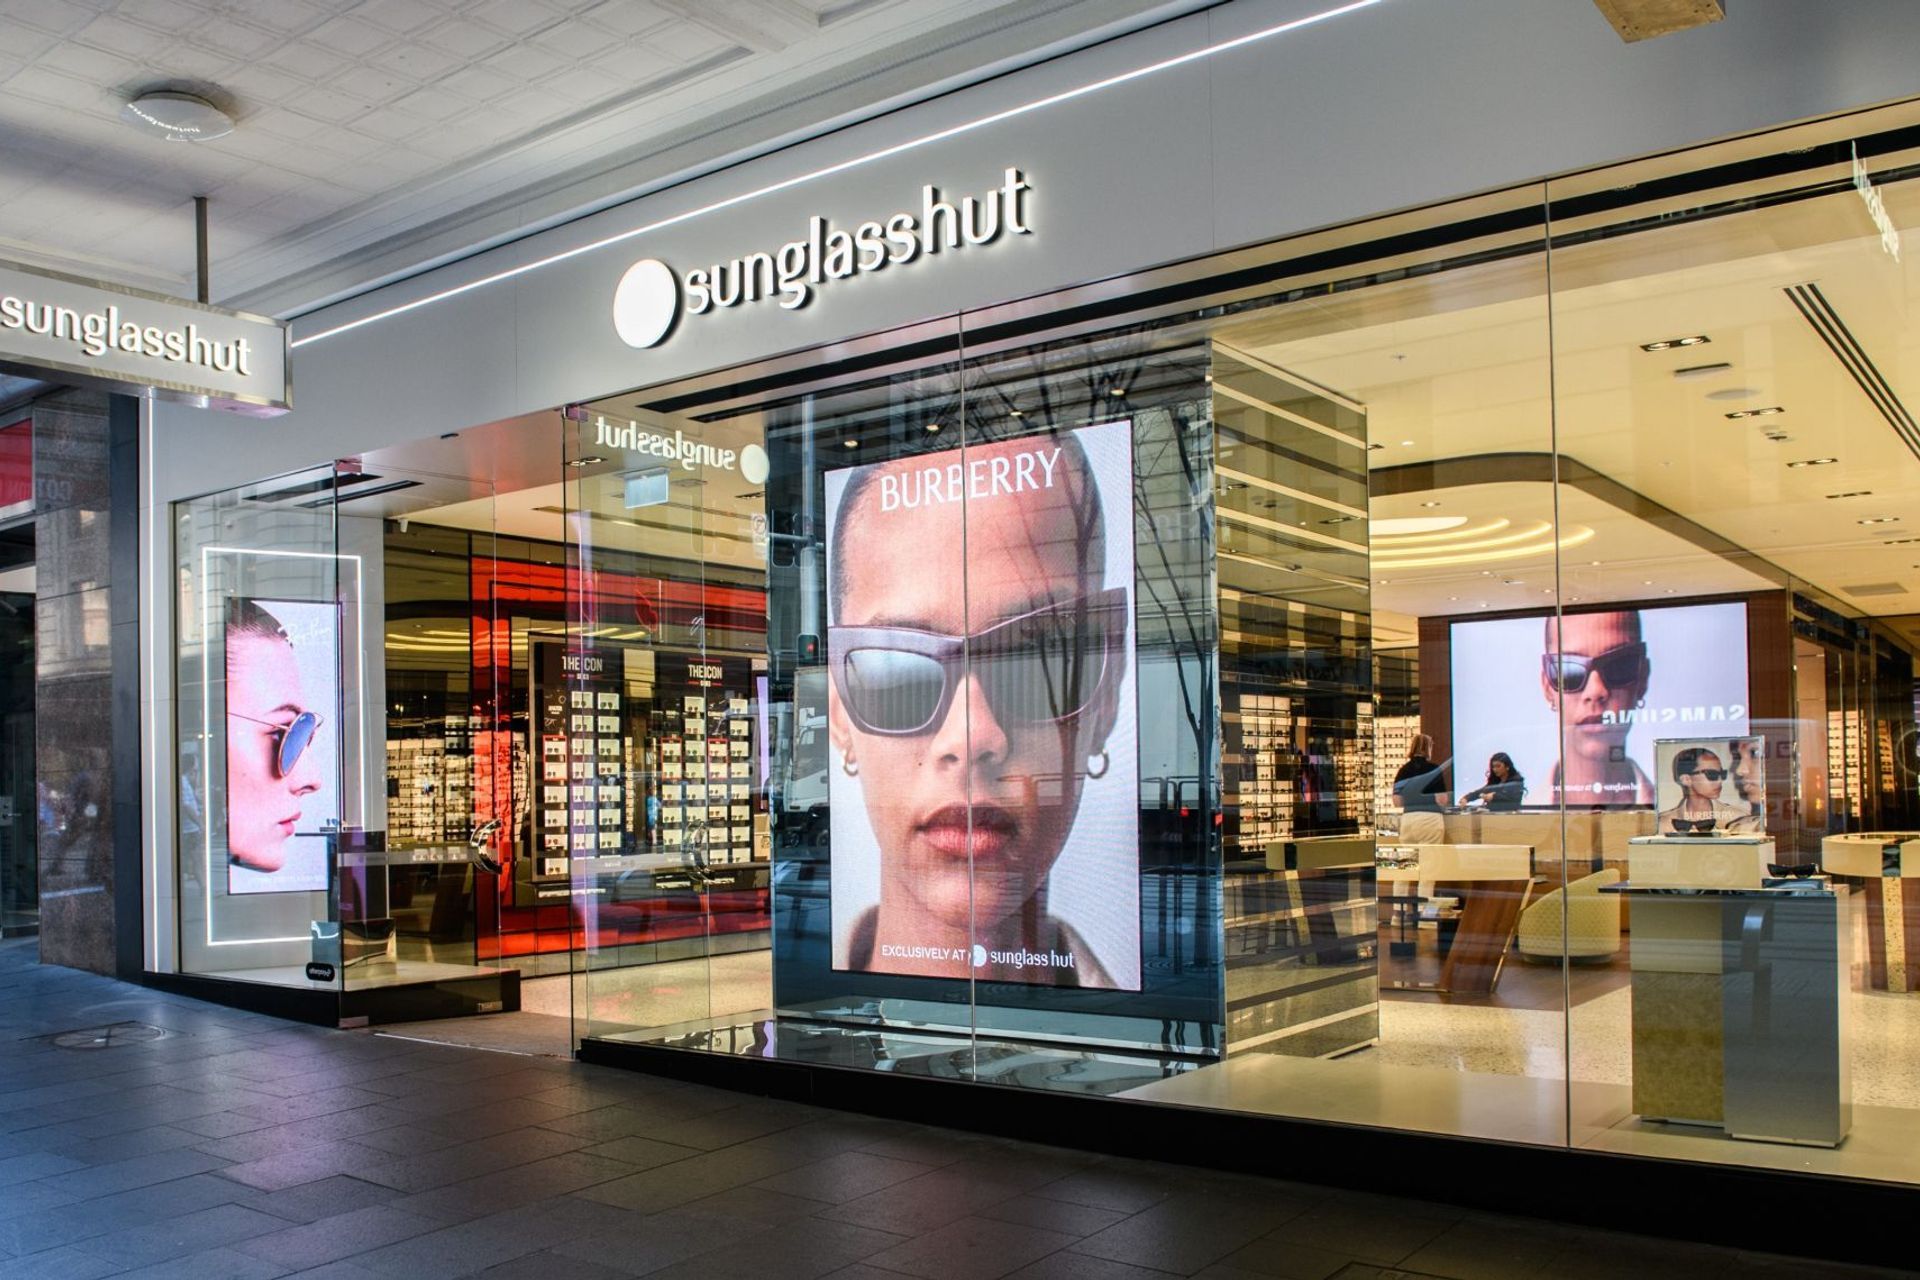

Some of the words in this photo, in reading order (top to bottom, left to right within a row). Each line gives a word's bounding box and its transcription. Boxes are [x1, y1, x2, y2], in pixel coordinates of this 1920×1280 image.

[685, 167, 1031, 314] sunglasshut
[1, 296, 251, 376] sunglasshut
[881, 447, 1061, 512] BURBERRY
[562, 656, 580, 671] THE
[688, 664, 703, 678] THE
[882, 944, 950, 961] EXCLUSIVELY
[951, 948, 966, 961] AT
[990, 947, 1049, 969] sunglass
[1050, 949, 1075, 968] hut
